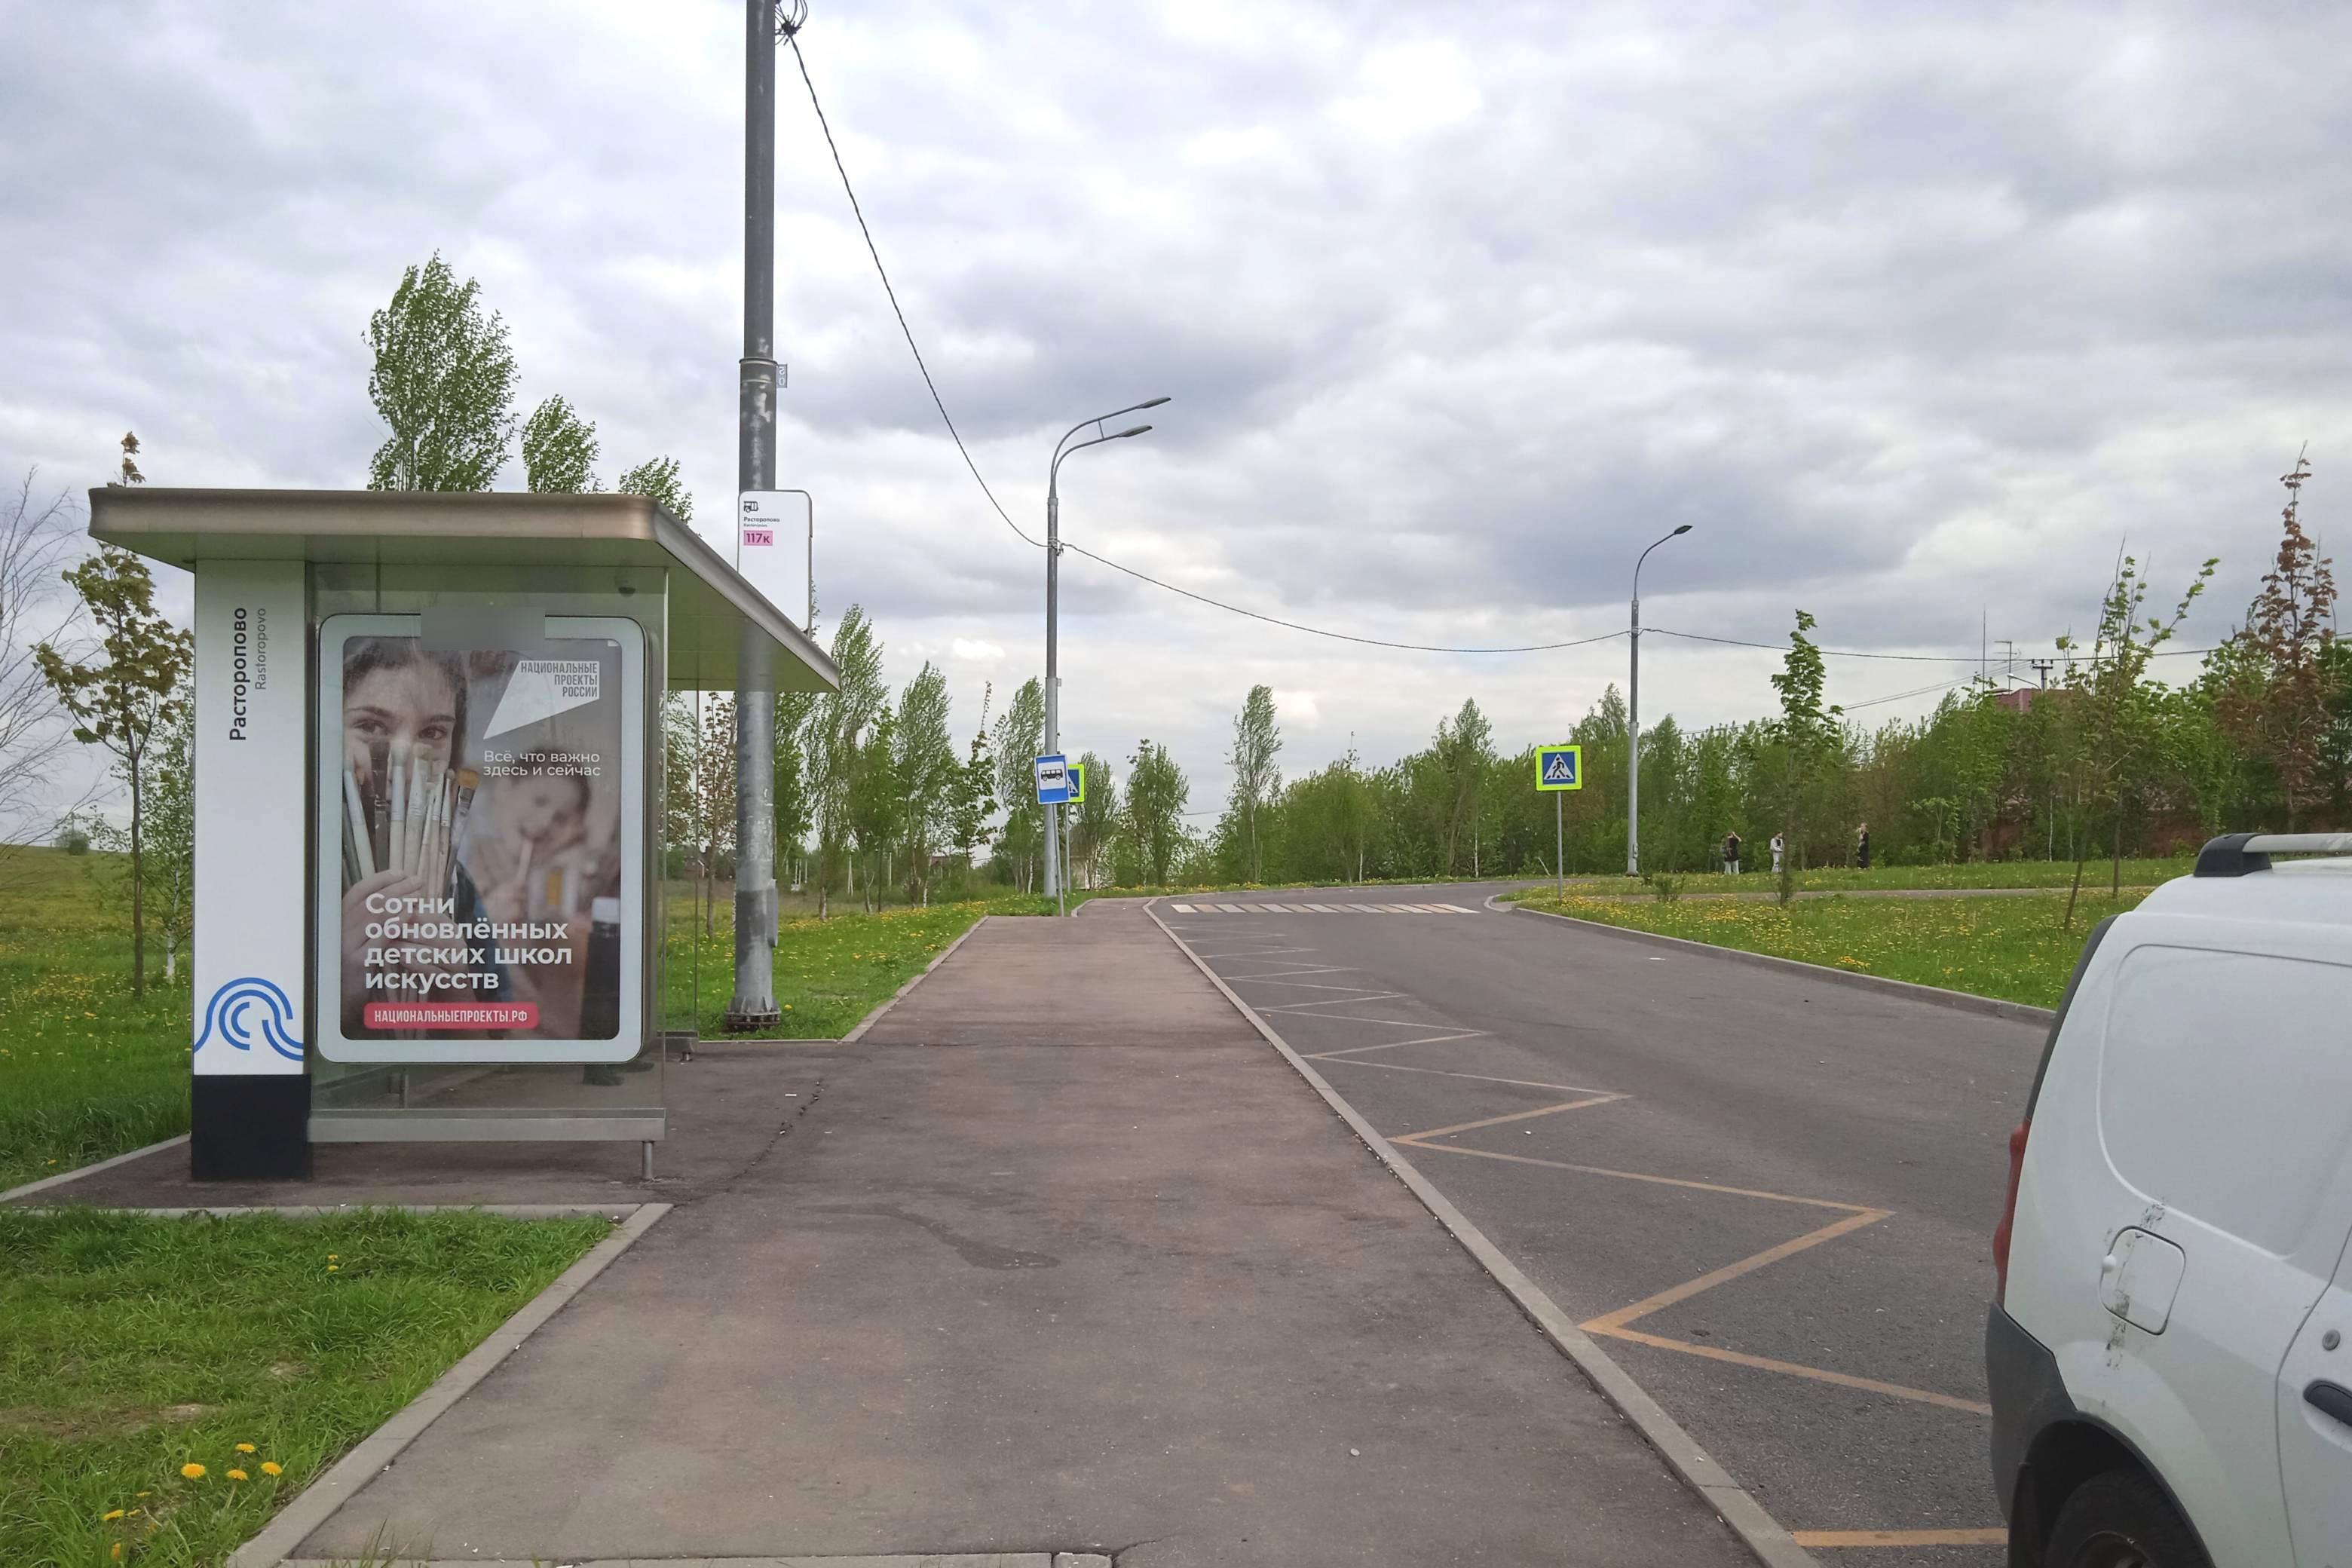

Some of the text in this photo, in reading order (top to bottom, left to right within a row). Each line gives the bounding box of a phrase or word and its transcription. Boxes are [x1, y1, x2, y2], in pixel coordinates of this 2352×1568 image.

[255, 608, 268, 690] Rastoropovo
[229, 608, 250, 740] Расторопово
[521, 662, 598, 675] НАЦИОНАЛЬНЫЕ
[554, 675, 598, 685] ПРОЕКТЫ
[562, 686, 598, 697] РОССИИ
[484, 750, 600, 764] Всё, что важно
[483, 764, 602, 777] здесь и сейчас
[365, 893, 455, 914] Сотни
[365, 917, 568, 940] обновлённых
[364, 947, 572, 967] детских школ
[365, 972, 499, 995] искусств
[374, 1010, 528, 1023] НАЦИОНАЛЬНЫЕПРОЕКТЫ.РФ
